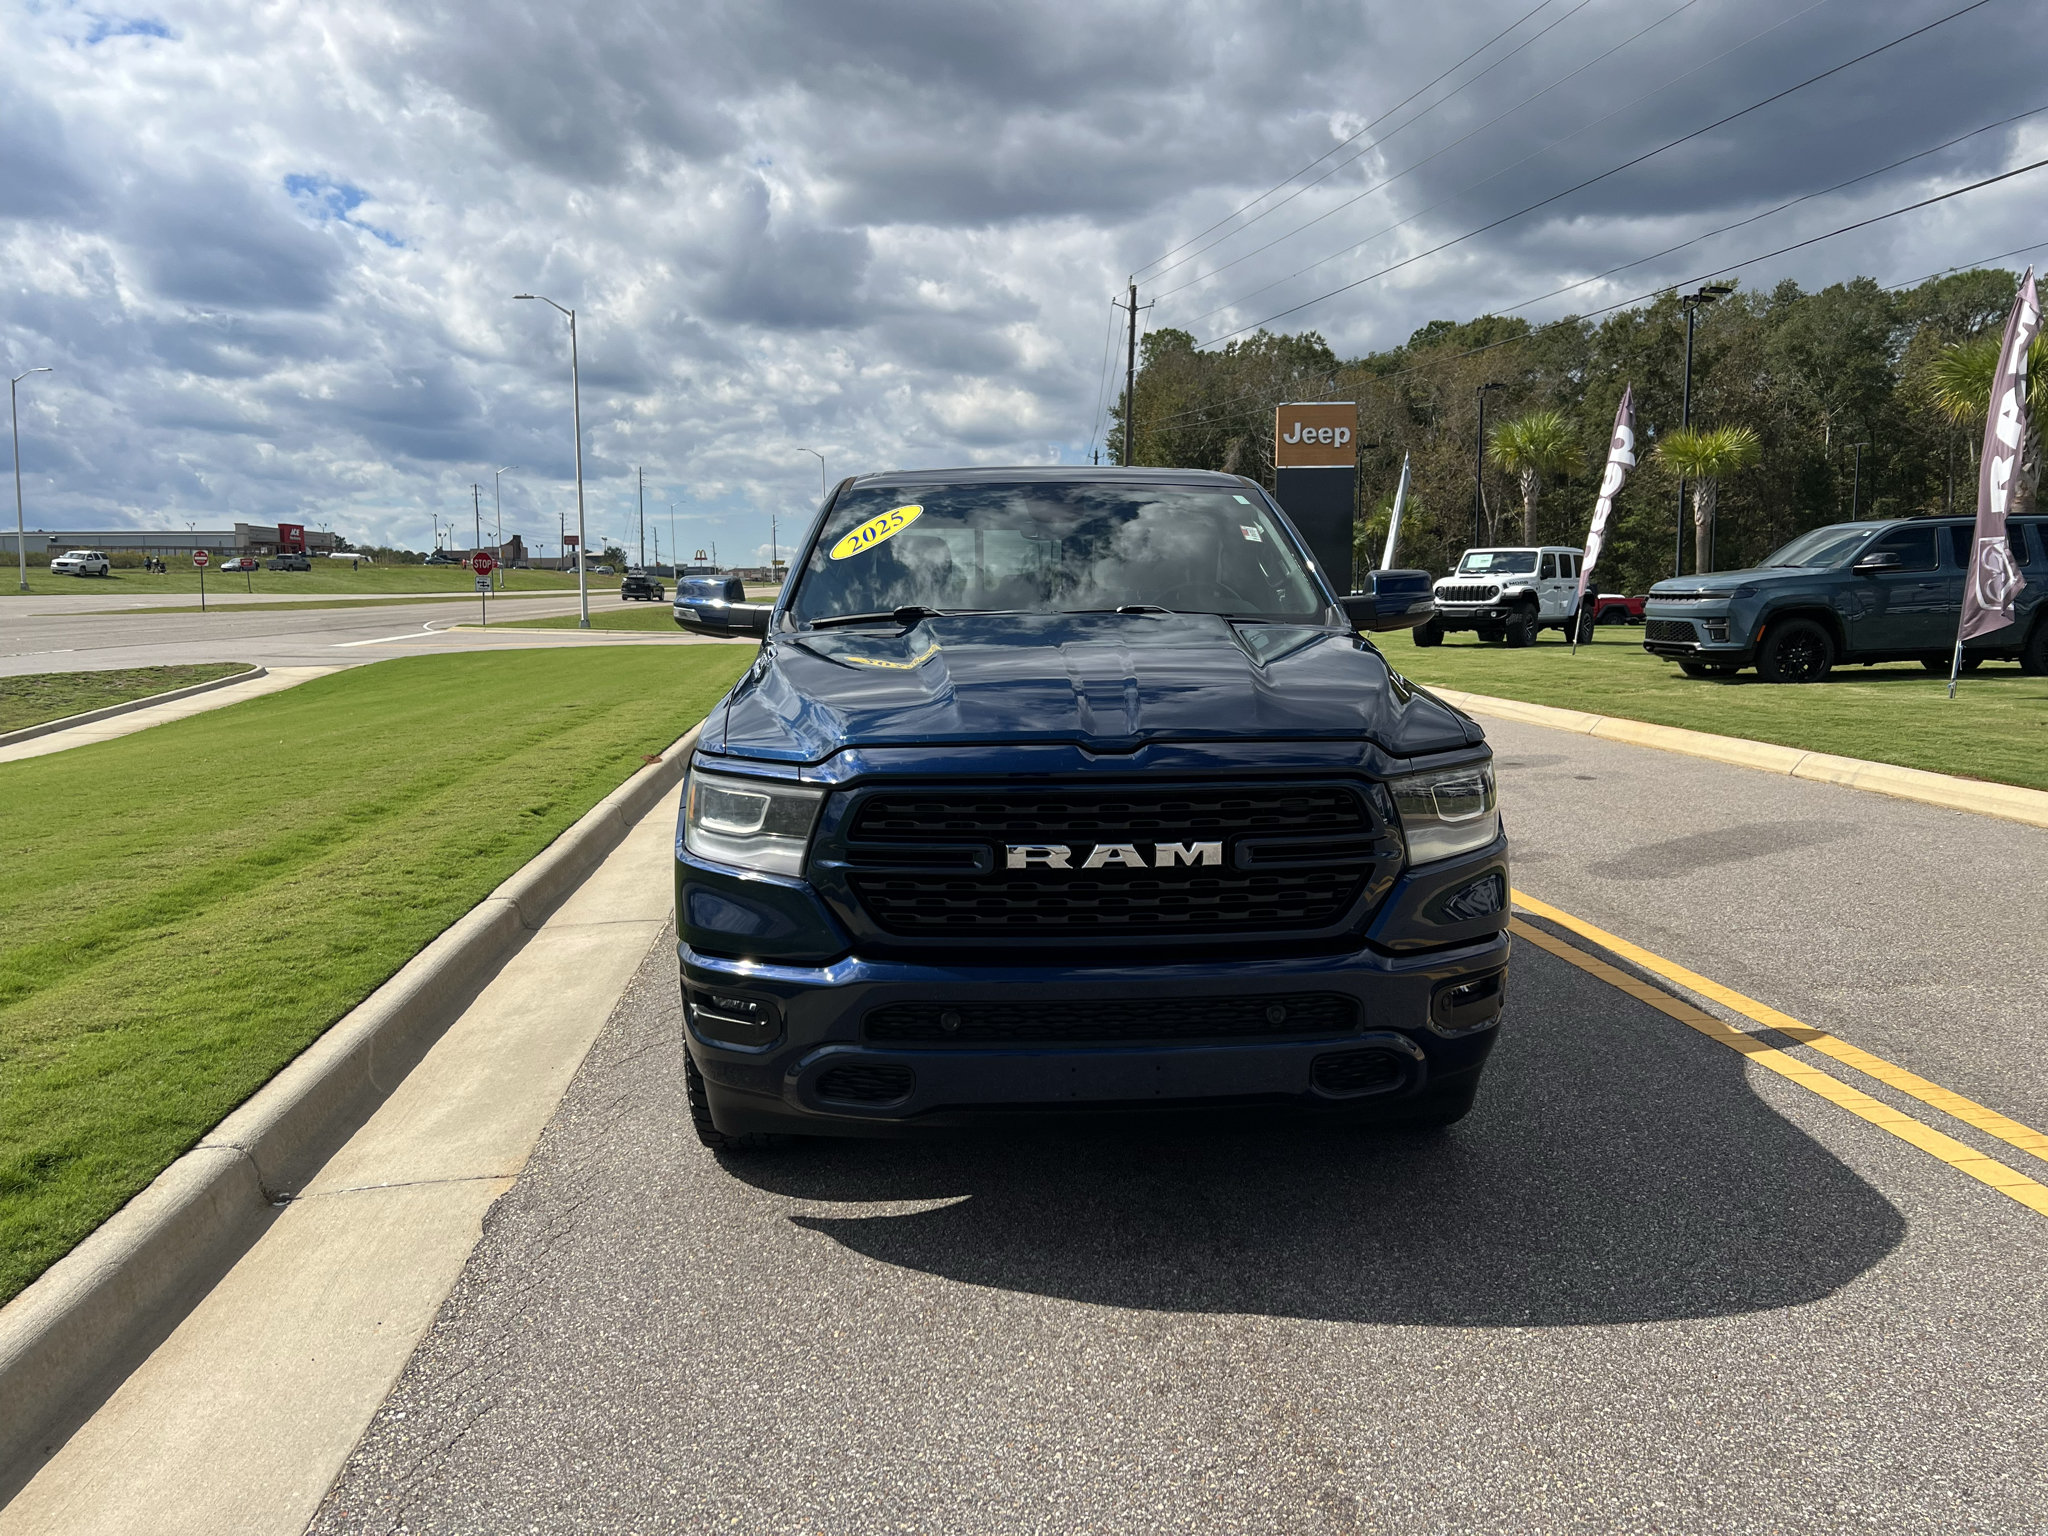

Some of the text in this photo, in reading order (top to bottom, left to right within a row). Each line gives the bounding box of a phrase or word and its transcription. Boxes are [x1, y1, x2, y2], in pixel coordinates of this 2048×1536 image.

[1283, 422, 1351, 448] Jeep
[847, 511, 904, 553] 2025
[474, 559, 491, 569] STOP
[1006, 841, 1222, 869] RAM
